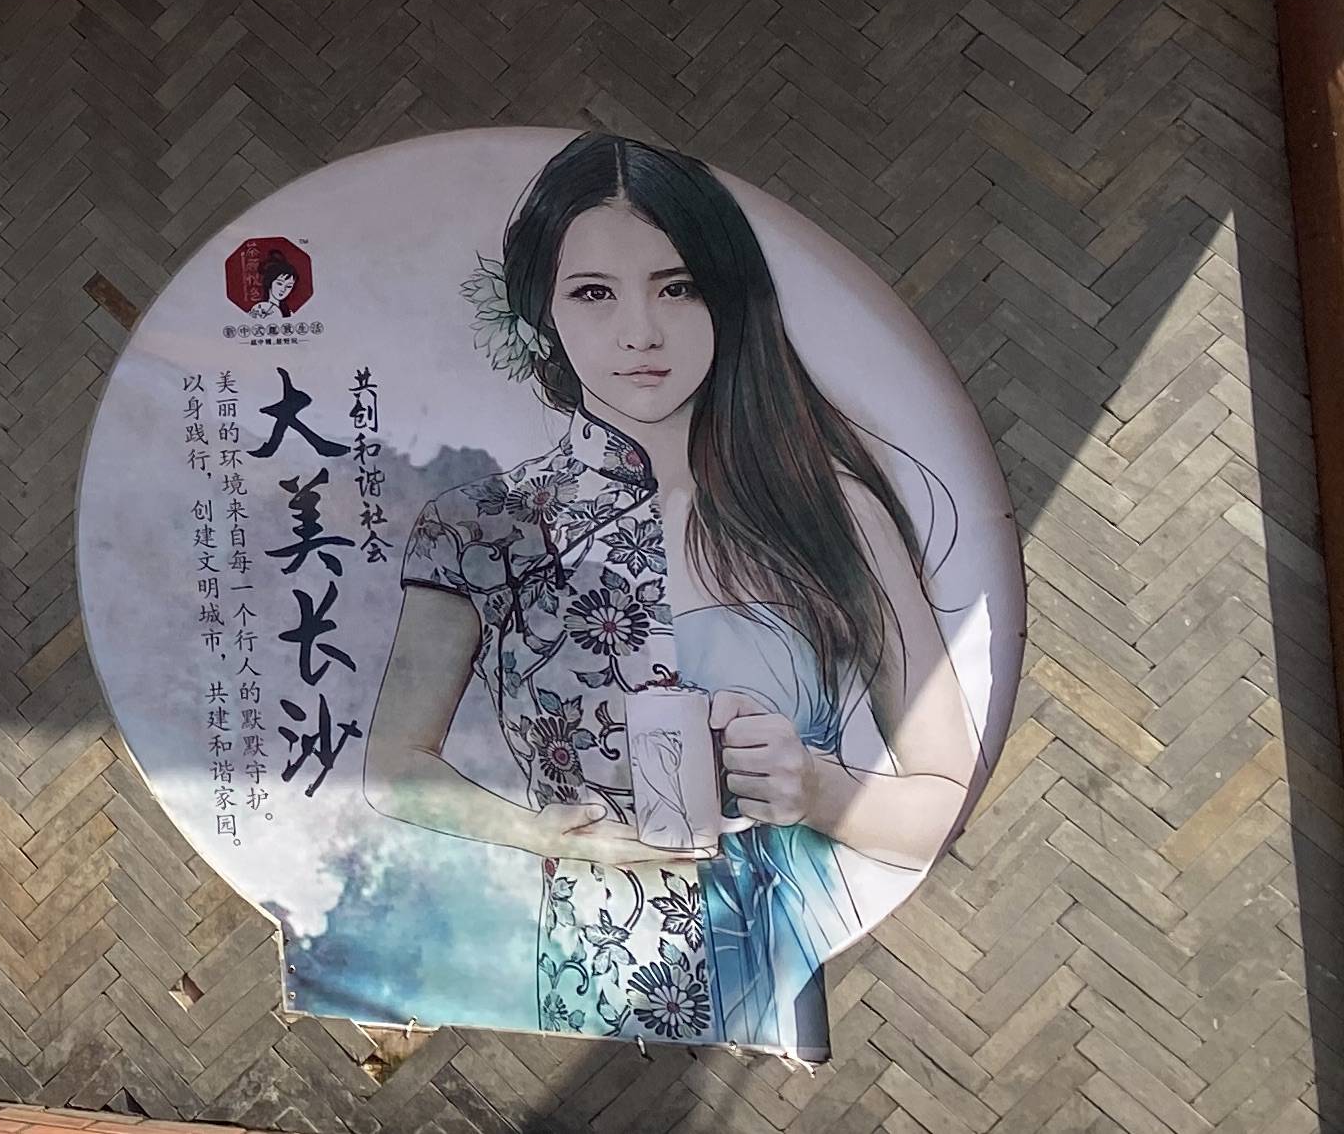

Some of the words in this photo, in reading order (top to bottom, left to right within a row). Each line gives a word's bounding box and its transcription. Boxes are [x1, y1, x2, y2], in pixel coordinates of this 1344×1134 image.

[246, 367, 363, 798] 大美长沙
[348, 367, 394, 563] 共创和谐社会
